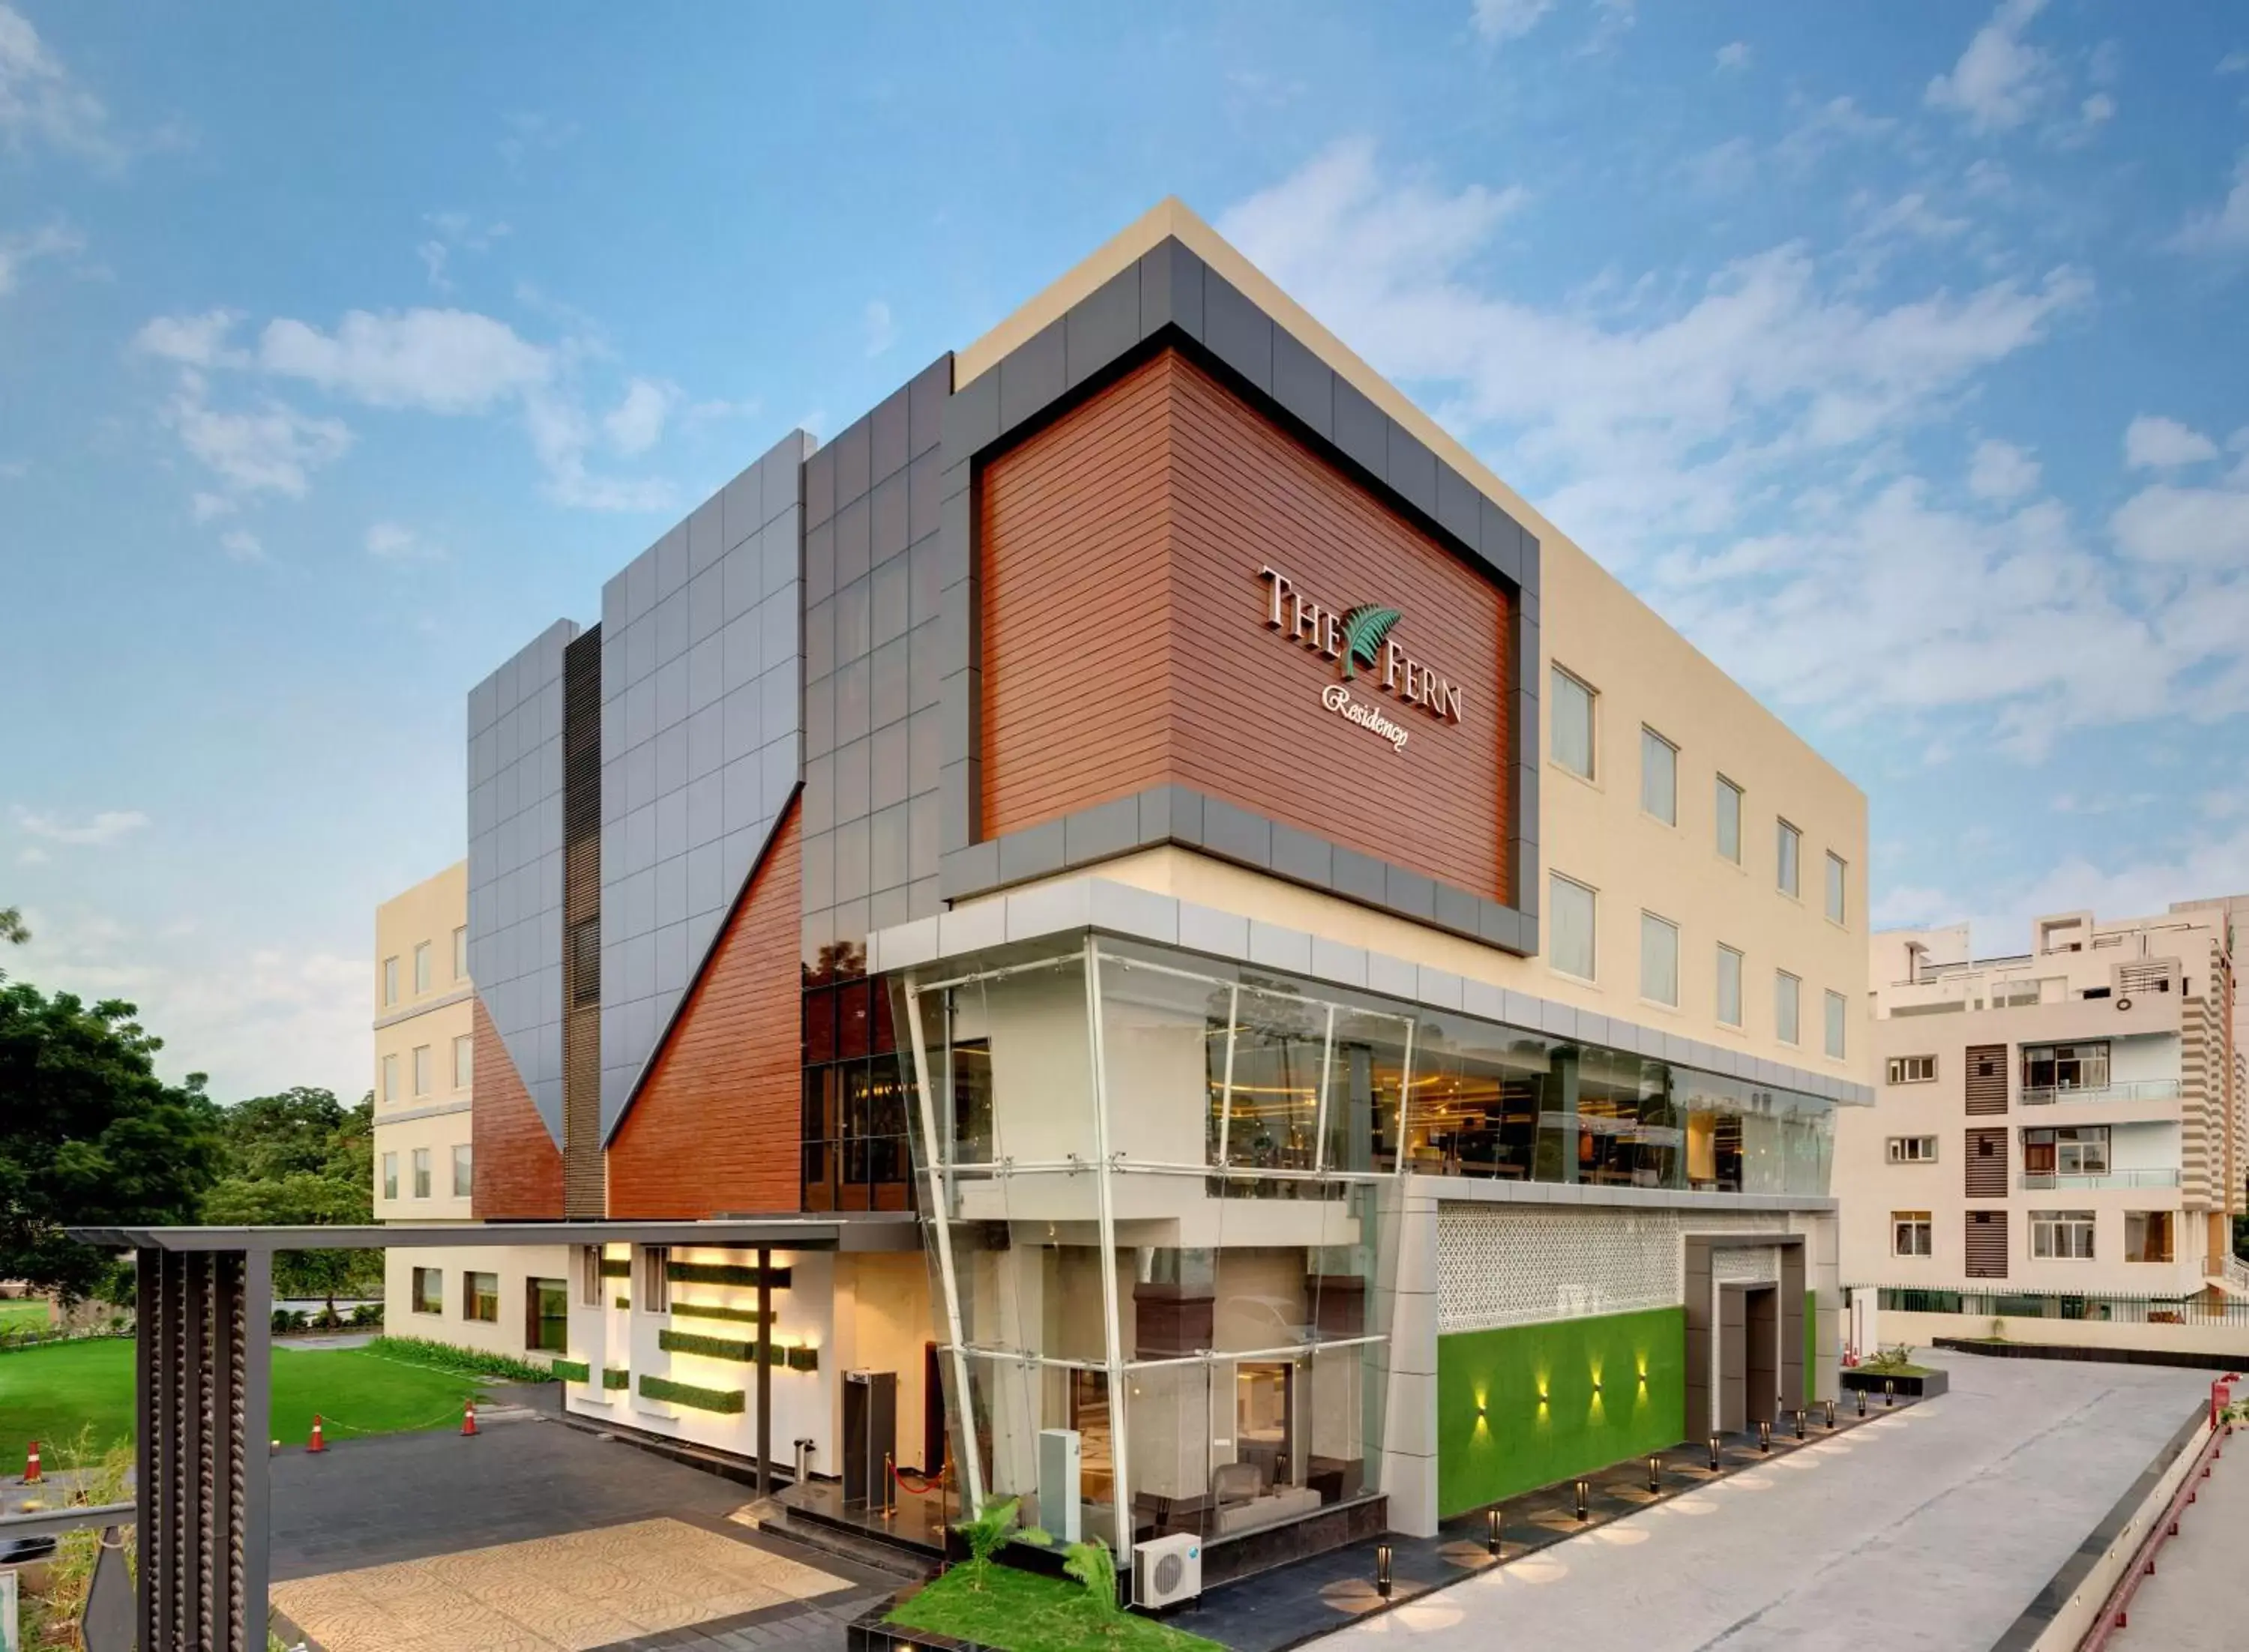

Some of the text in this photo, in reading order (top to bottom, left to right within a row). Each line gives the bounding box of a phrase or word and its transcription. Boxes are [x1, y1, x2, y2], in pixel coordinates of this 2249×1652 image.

[1258, 565, 1463, 724] THE FERN
[1322, 684, 1409, 753] Residency
